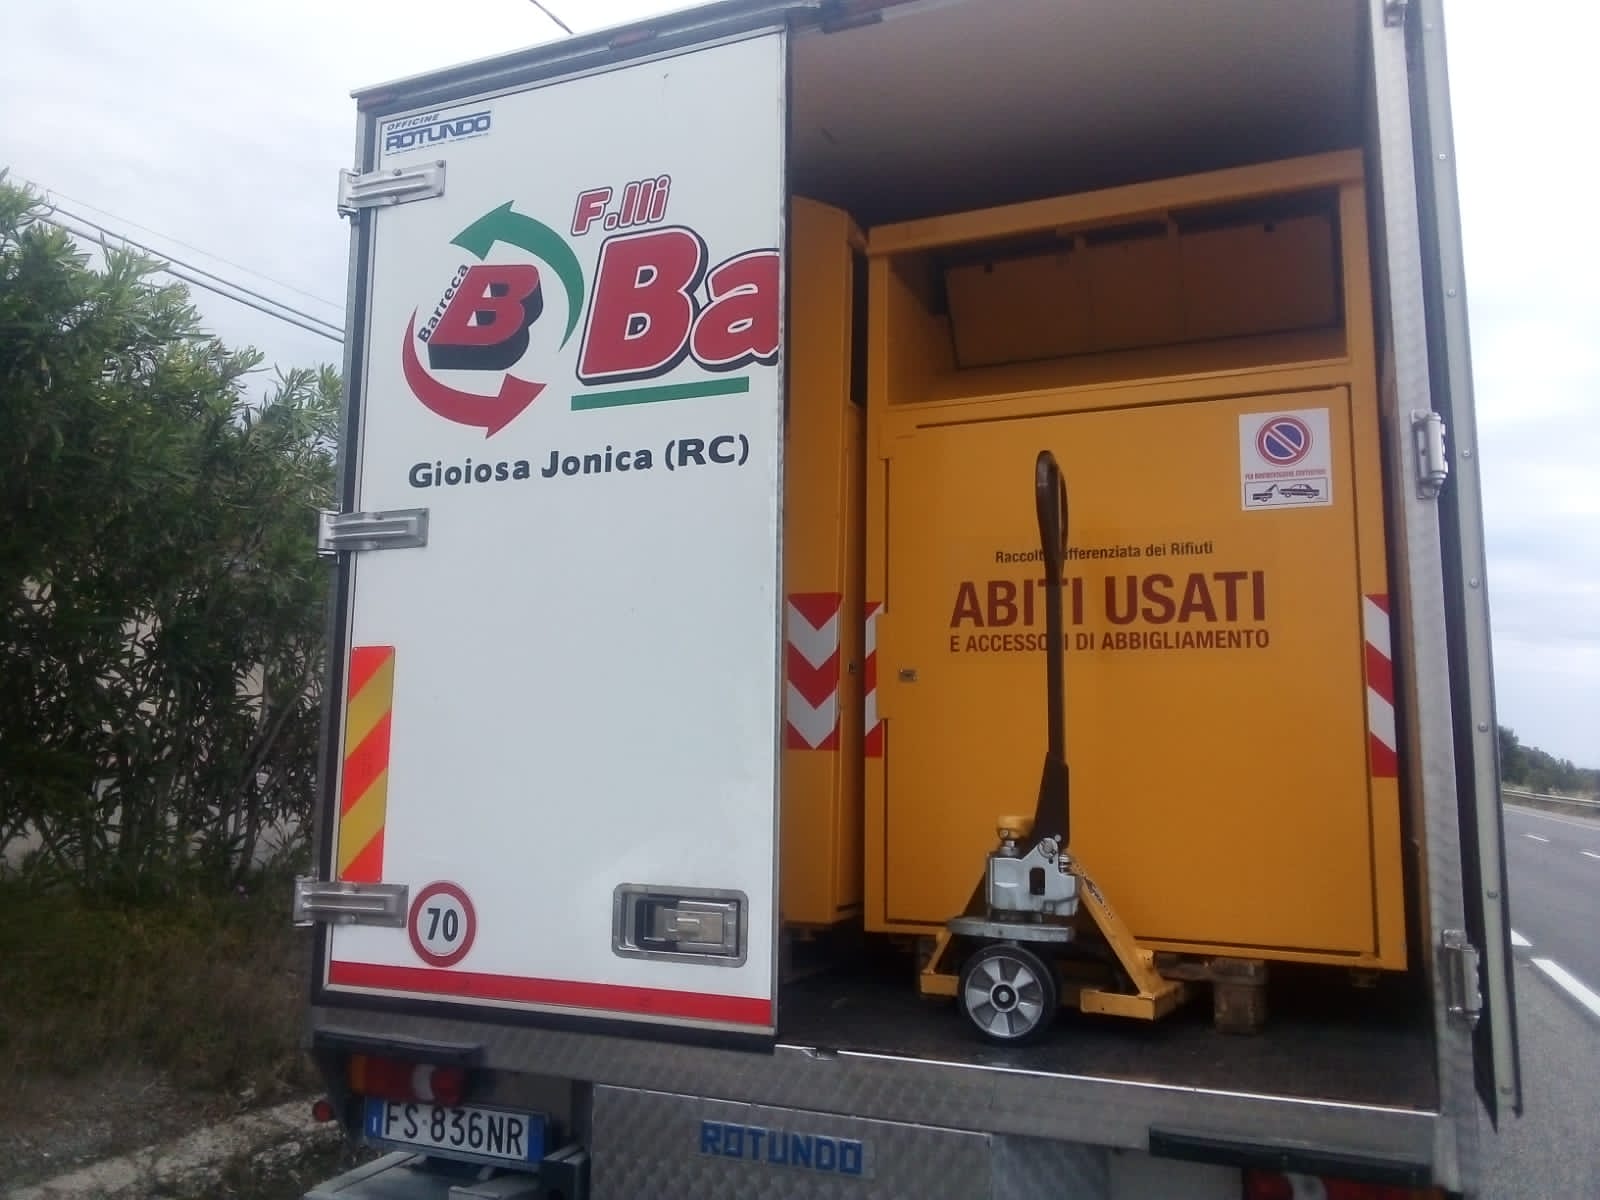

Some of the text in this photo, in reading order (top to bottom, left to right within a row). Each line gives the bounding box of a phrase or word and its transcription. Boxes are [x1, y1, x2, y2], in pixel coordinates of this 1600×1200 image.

[385, 115, 492, 151] ROTUNDO
[387, 113, 440, 131] OFFICINE
[417, 264, 469, 343] Barreca
[427, 264, 543, 371] B
[408, 434, 750, 488] Gioiosa Jonica (RC)
[995, 541, 1213, 563] Raccolt ifferenziata dei Rifiuti
[950, 571, 1266, 628] ABII USATI
[950, 628, 1270, 652] E ACCESSOI DI ABBIGLIAMENTO
[427, 907, 459, 942] 70
[385, 1103, 419, 1139] FS
[430, 1105, 524, 1156] 836NR
[702, 1121, 863, 1175] ROTUNDO
